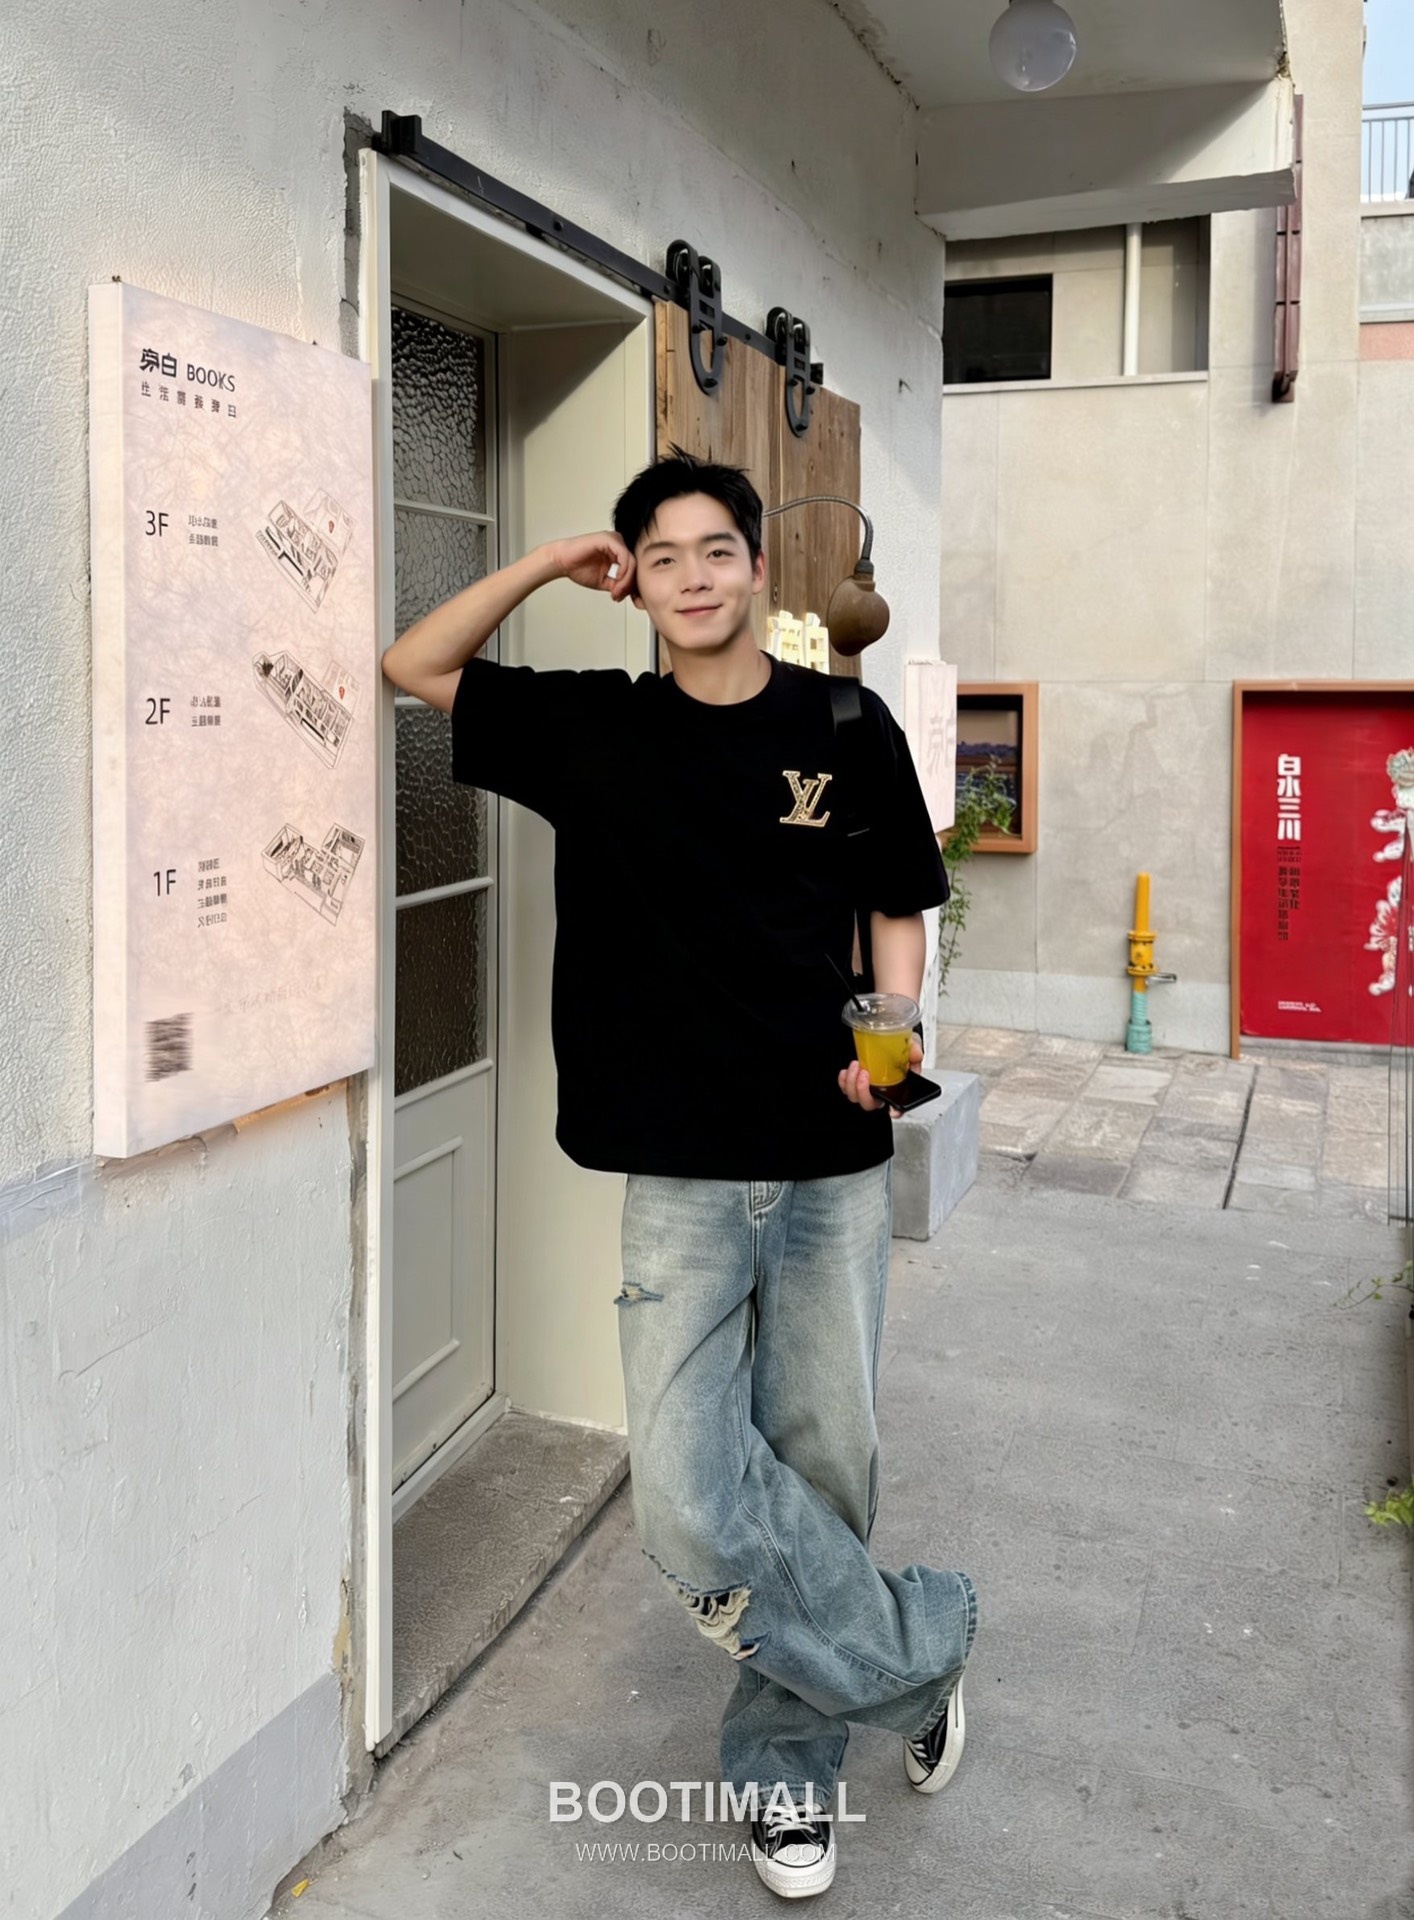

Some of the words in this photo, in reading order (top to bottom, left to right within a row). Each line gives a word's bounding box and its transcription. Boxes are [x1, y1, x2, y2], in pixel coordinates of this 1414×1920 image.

[187, 363, 235, 392] BOOKS
[145, 510, 169, 537] 3F
[145, 697, 171, 725] 2F
[153, 869, 176, 897] 1F
